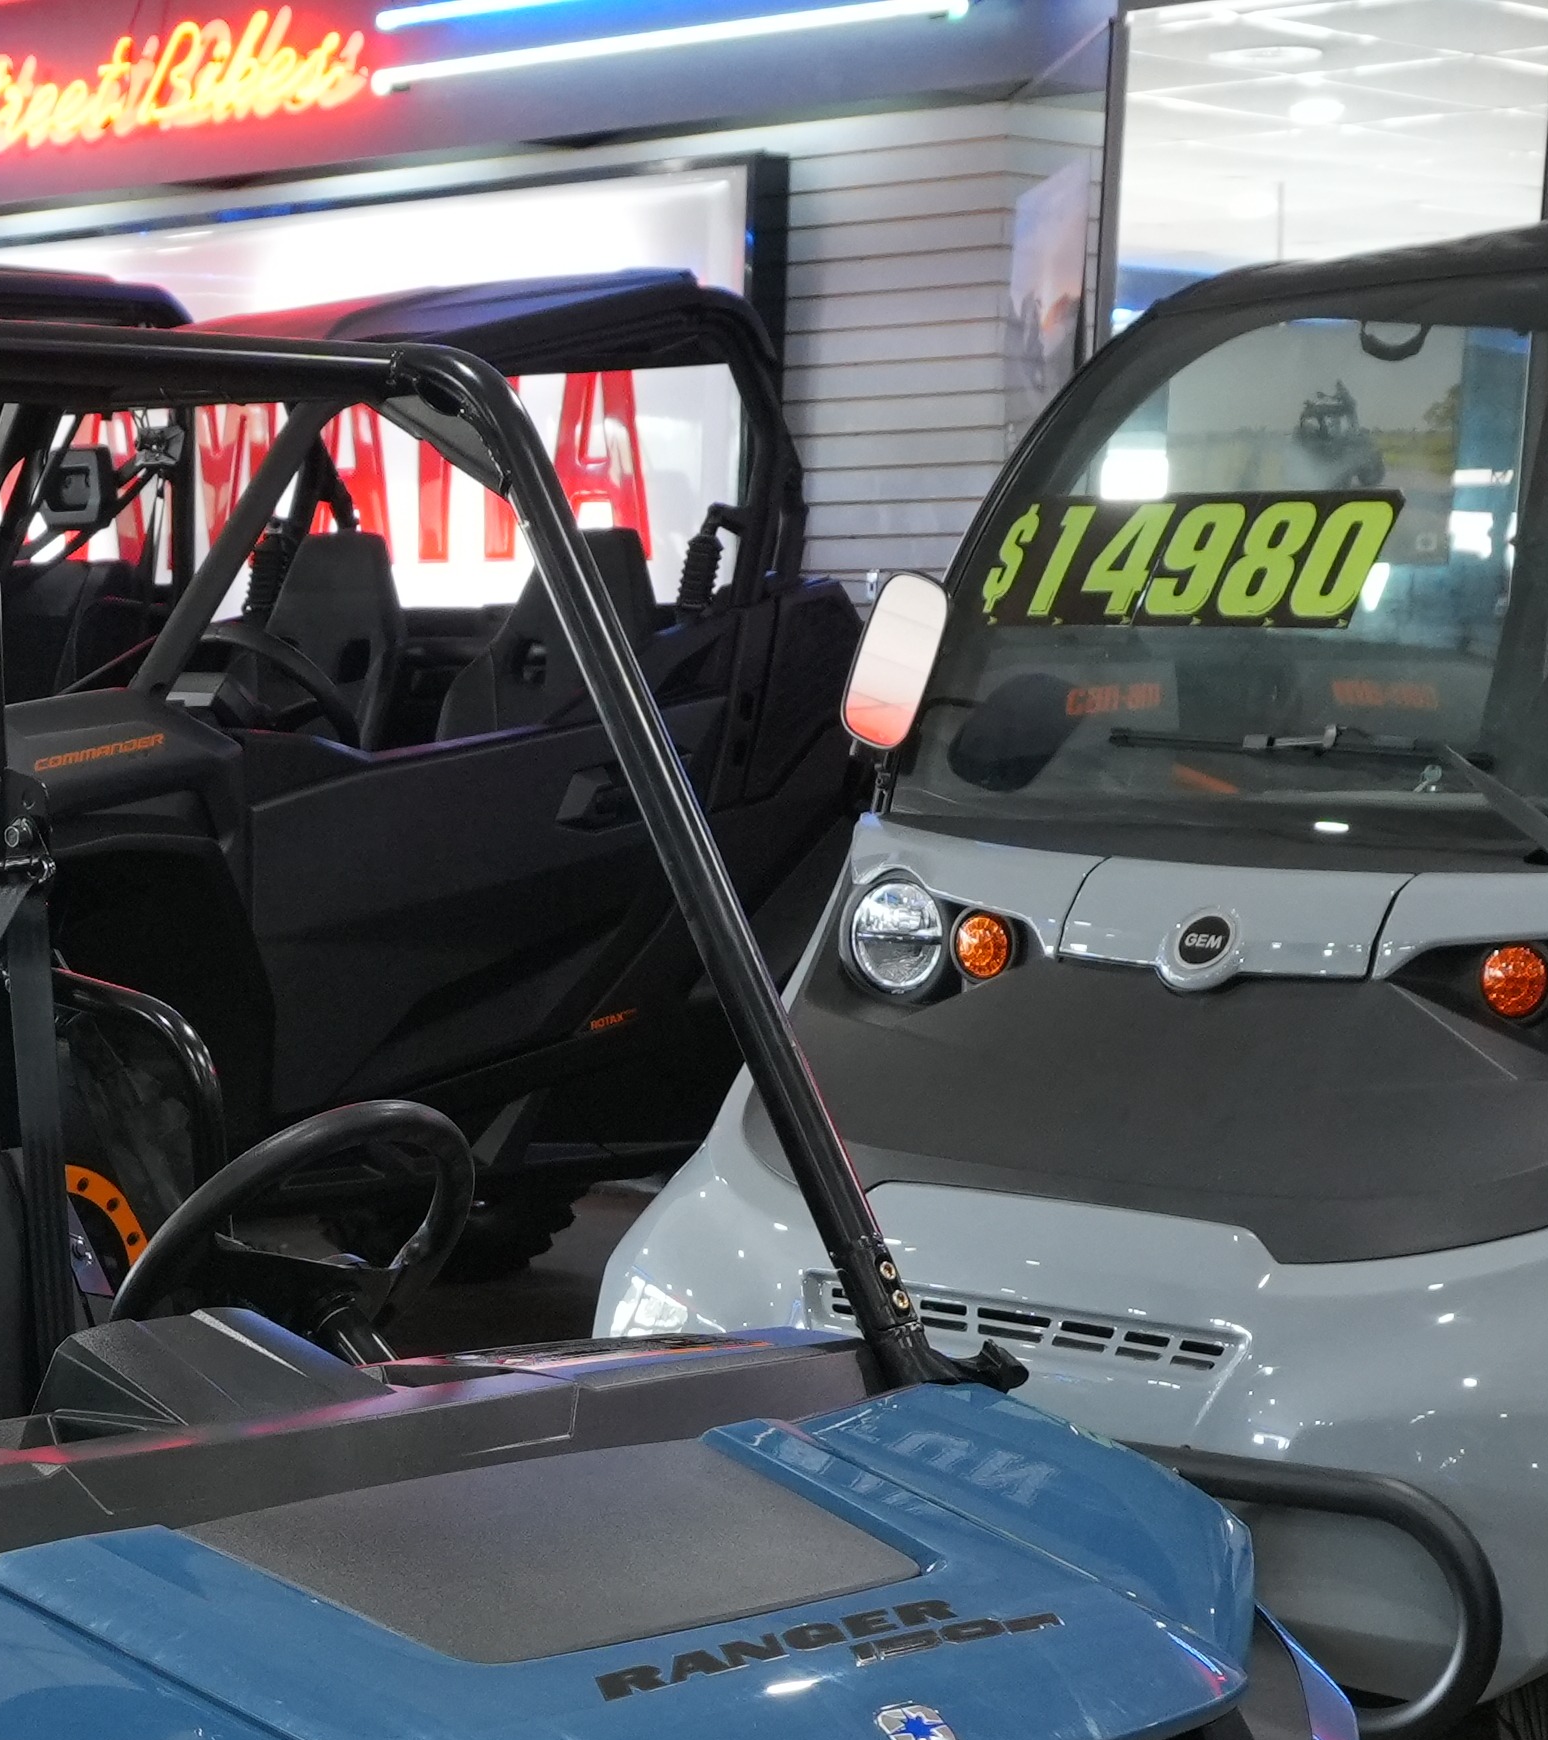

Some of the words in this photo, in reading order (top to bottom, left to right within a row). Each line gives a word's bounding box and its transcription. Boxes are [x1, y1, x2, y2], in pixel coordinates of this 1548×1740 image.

[141, 9, 358, 124] Bikes
[982, 500, 1394, 618] $14980
[35, 733, 166, 772] COMMANDER
[1185, 932, 1223, 950] GEM
[595, 1599, 959, 1701] RANGER
